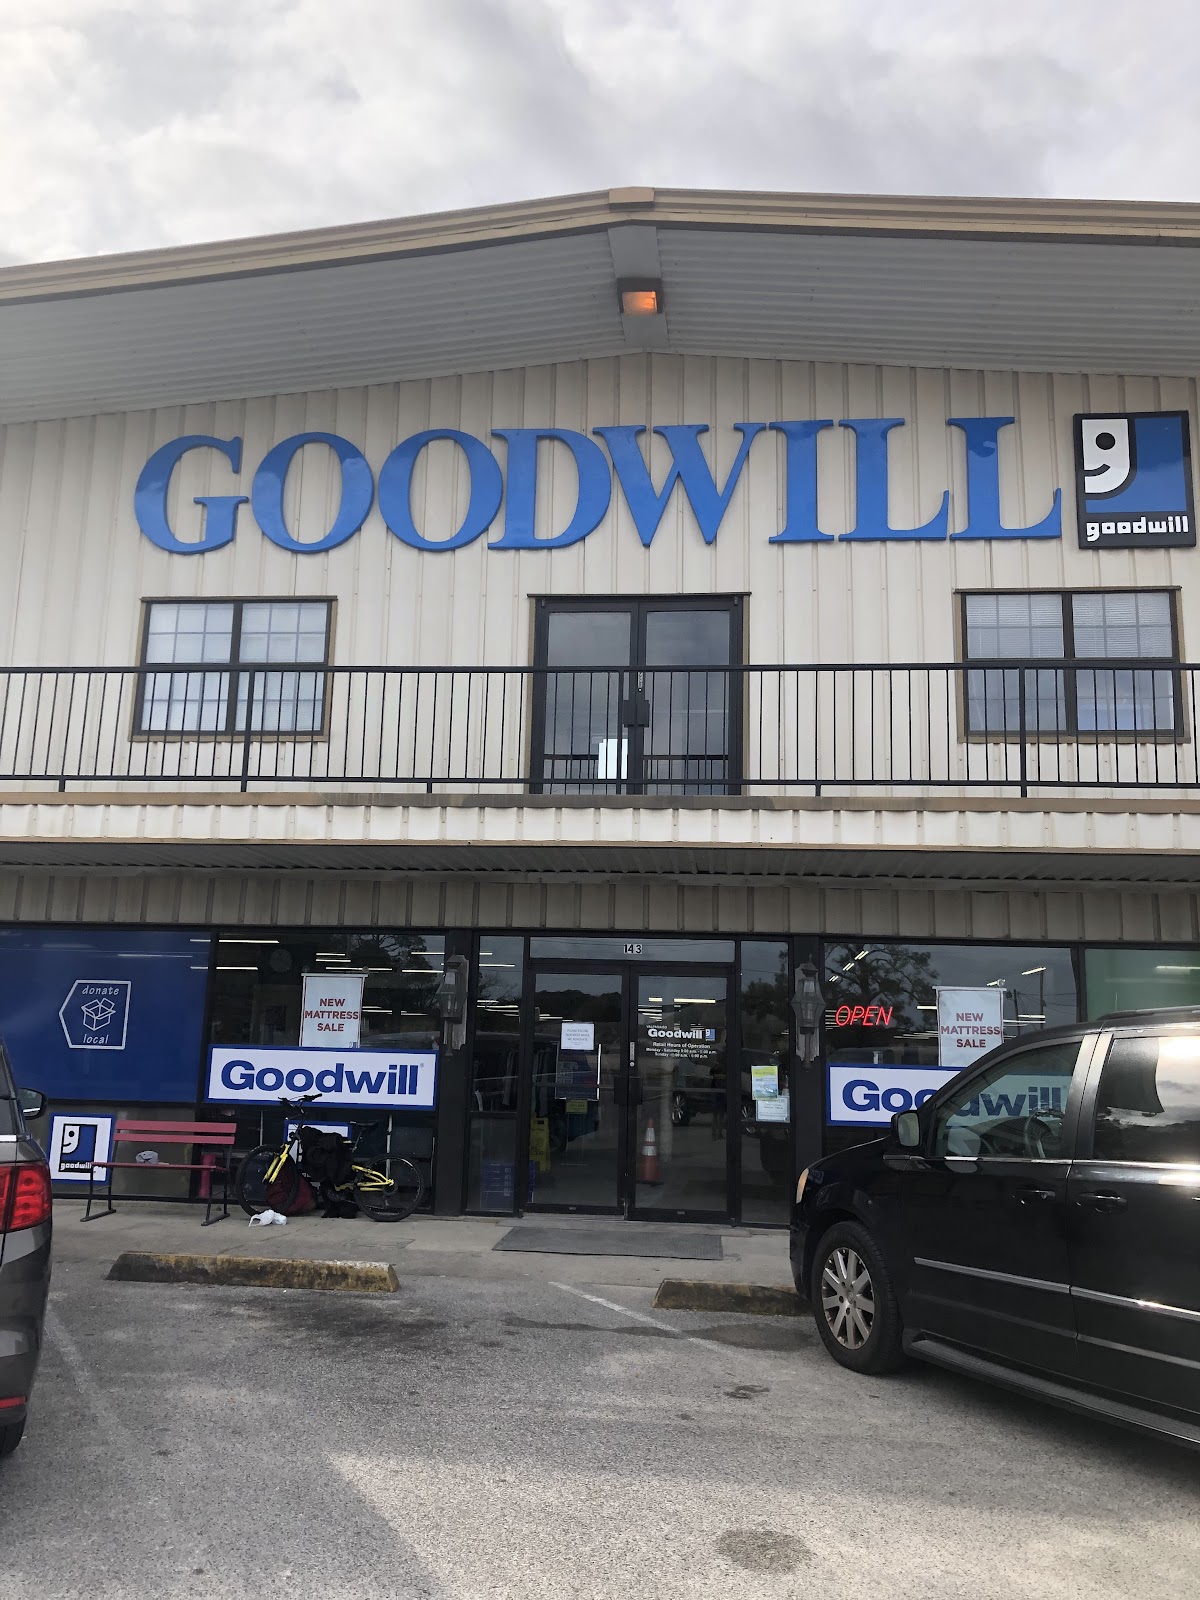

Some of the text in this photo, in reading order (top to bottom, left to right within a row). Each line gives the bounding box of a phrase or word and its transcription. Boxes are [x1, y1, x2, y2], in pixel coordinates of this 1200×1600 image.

[134, 416, 1062, 556] GOODWILL
[1086, 516, 1189, 542] goodwill
[624, 944, 642, 954] 143
[81, 984, 120, 996] donate
[319, 998, 346, 1007] NEW
[304, 1010, 359, 1020] MATTRESS
[835, 1005, 893, 1026] OPEN
[956, 1012, 984, 1022] NEW
[316, 1022, 345, 1032] SALE
[940, 1025, 1001, 1035] MATTRESS
[647, 1028, 703, 1039] Goodwill
[82, 1033, 110, 1045] local
[956, 1038, 987, 1048] SALE
[220, 1060, 419, 1095] Goodwill
